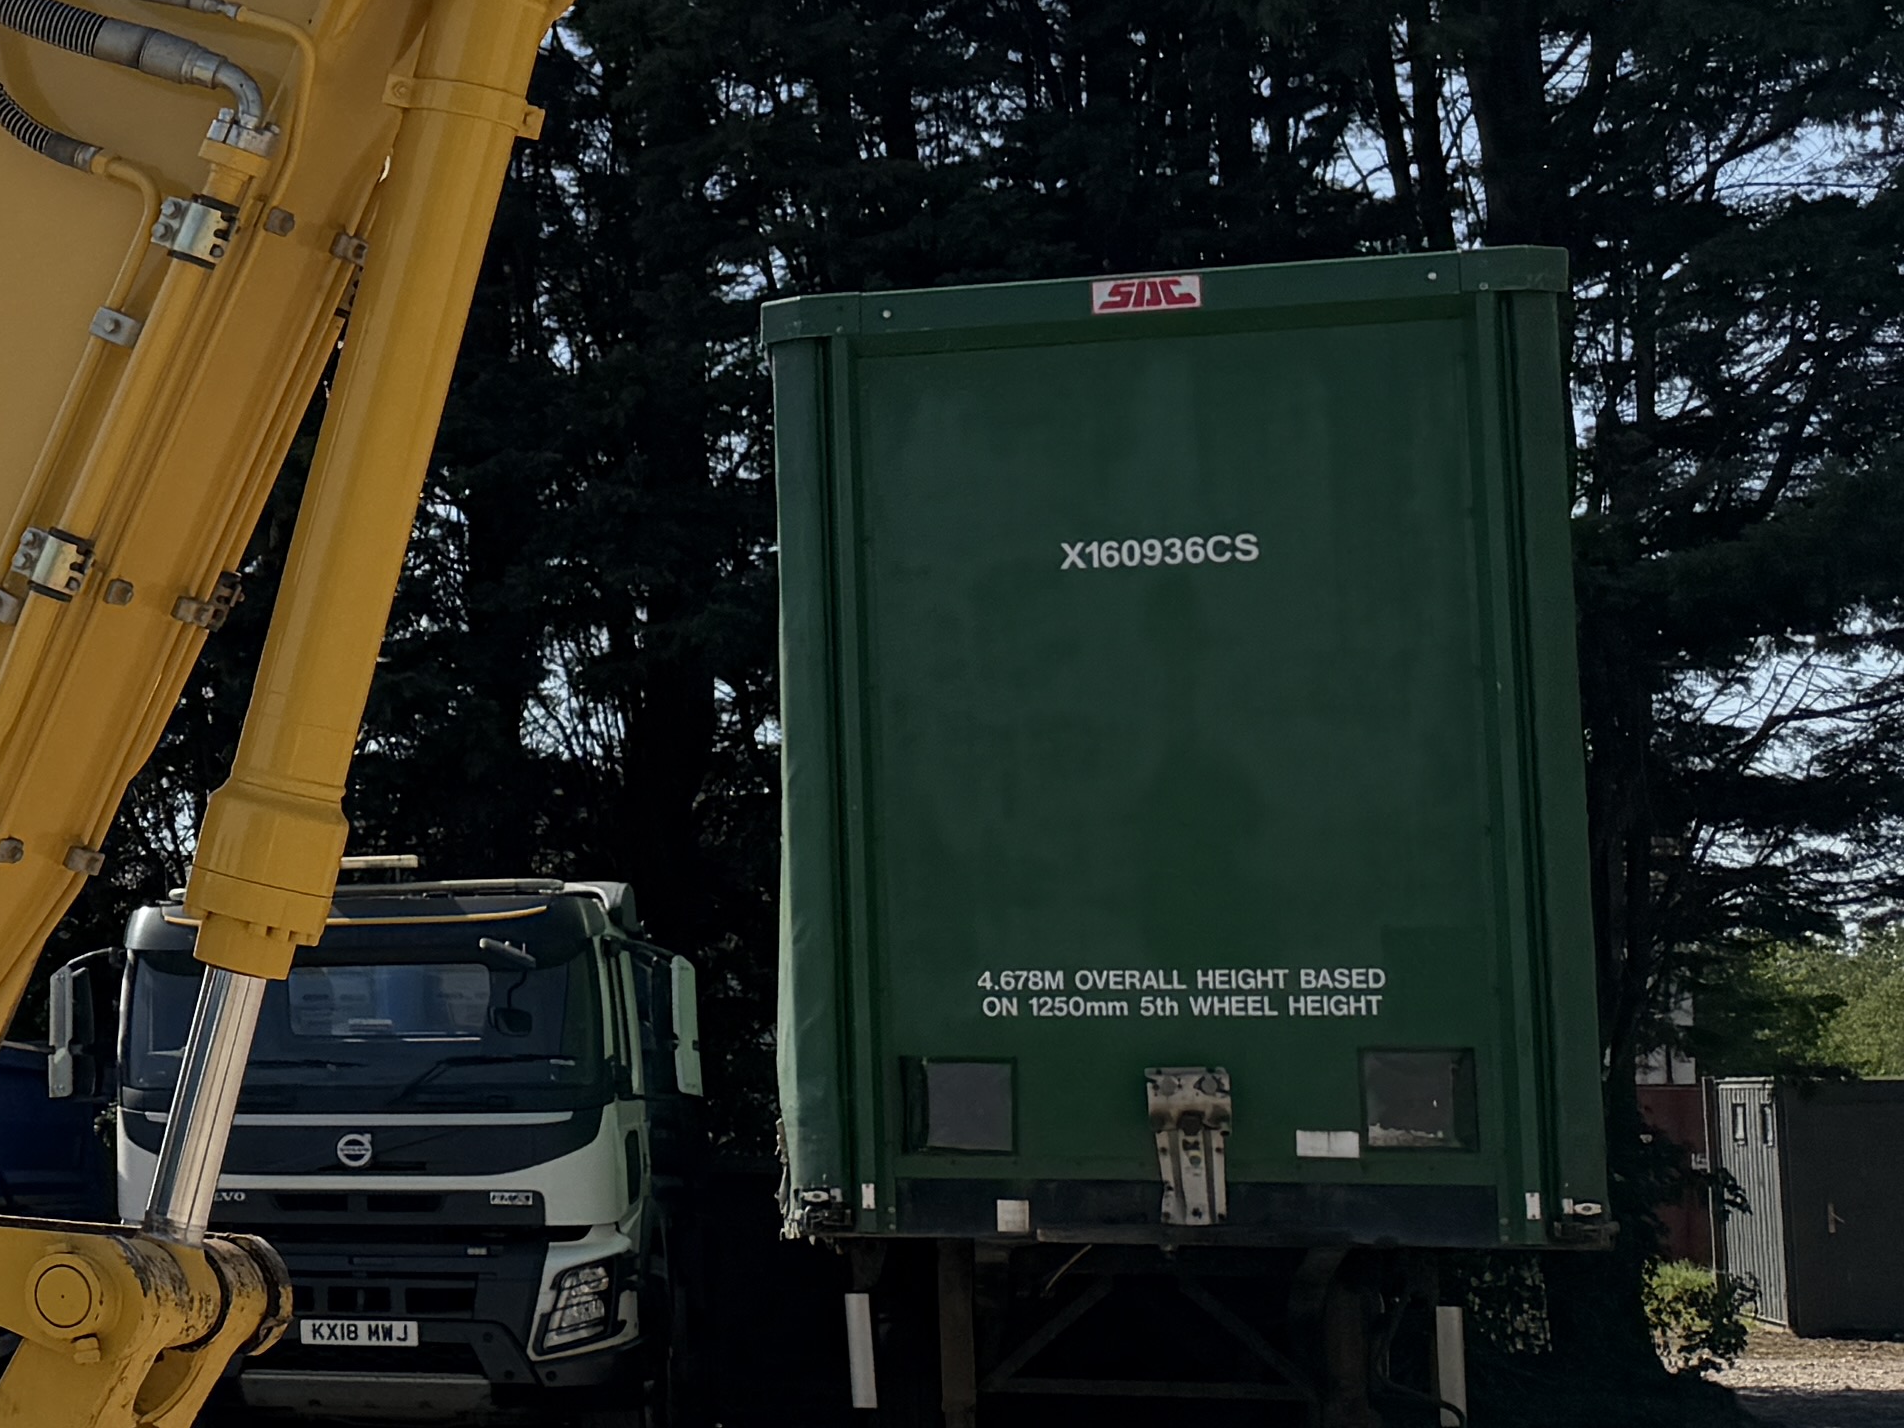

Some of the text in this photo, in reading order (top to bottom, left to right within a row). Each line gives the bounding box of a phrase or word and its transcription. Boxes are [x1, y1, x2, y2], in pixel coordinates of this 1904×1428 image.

[1098, 279, 1196, 310] SDC
[1060, 533, 1260, 570] X160936CS
[977, 968, 1386, 991] 4.678M OVERALL HEIGHT BASED
[982, 995, 1383, 1017] ON 1250mm 5th WHEEL HEIGHT
[312, 1323, 408, 1342] KX18 MWJ
